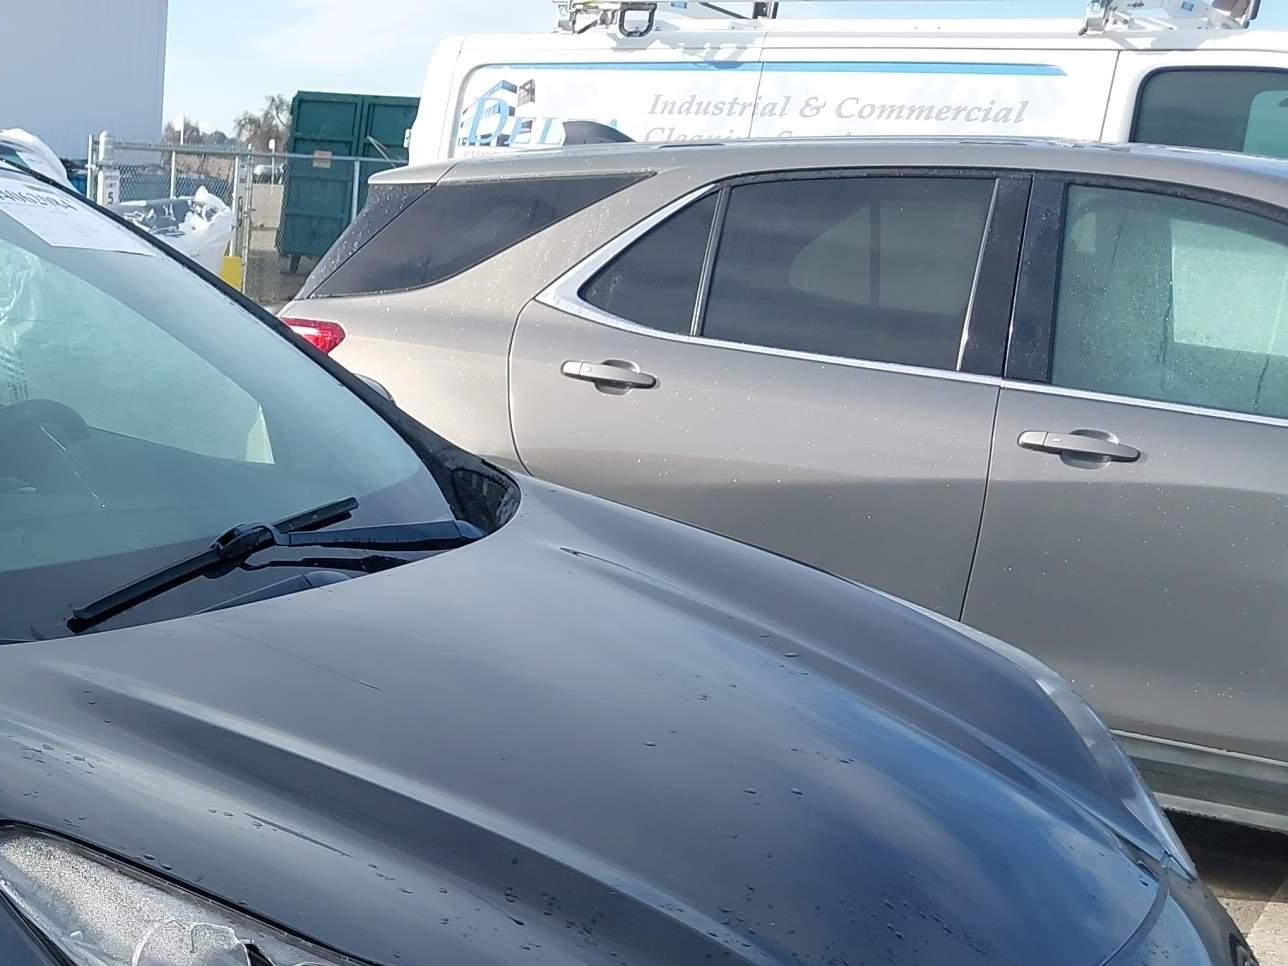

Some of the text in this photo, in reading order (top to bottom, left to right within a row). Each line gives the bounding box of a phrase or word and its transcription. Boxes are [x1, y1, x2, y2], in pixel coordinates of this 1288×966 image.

[647, 93, 1030, 124] Industrial & Commercial
[107, 191, 114, 204] 5
